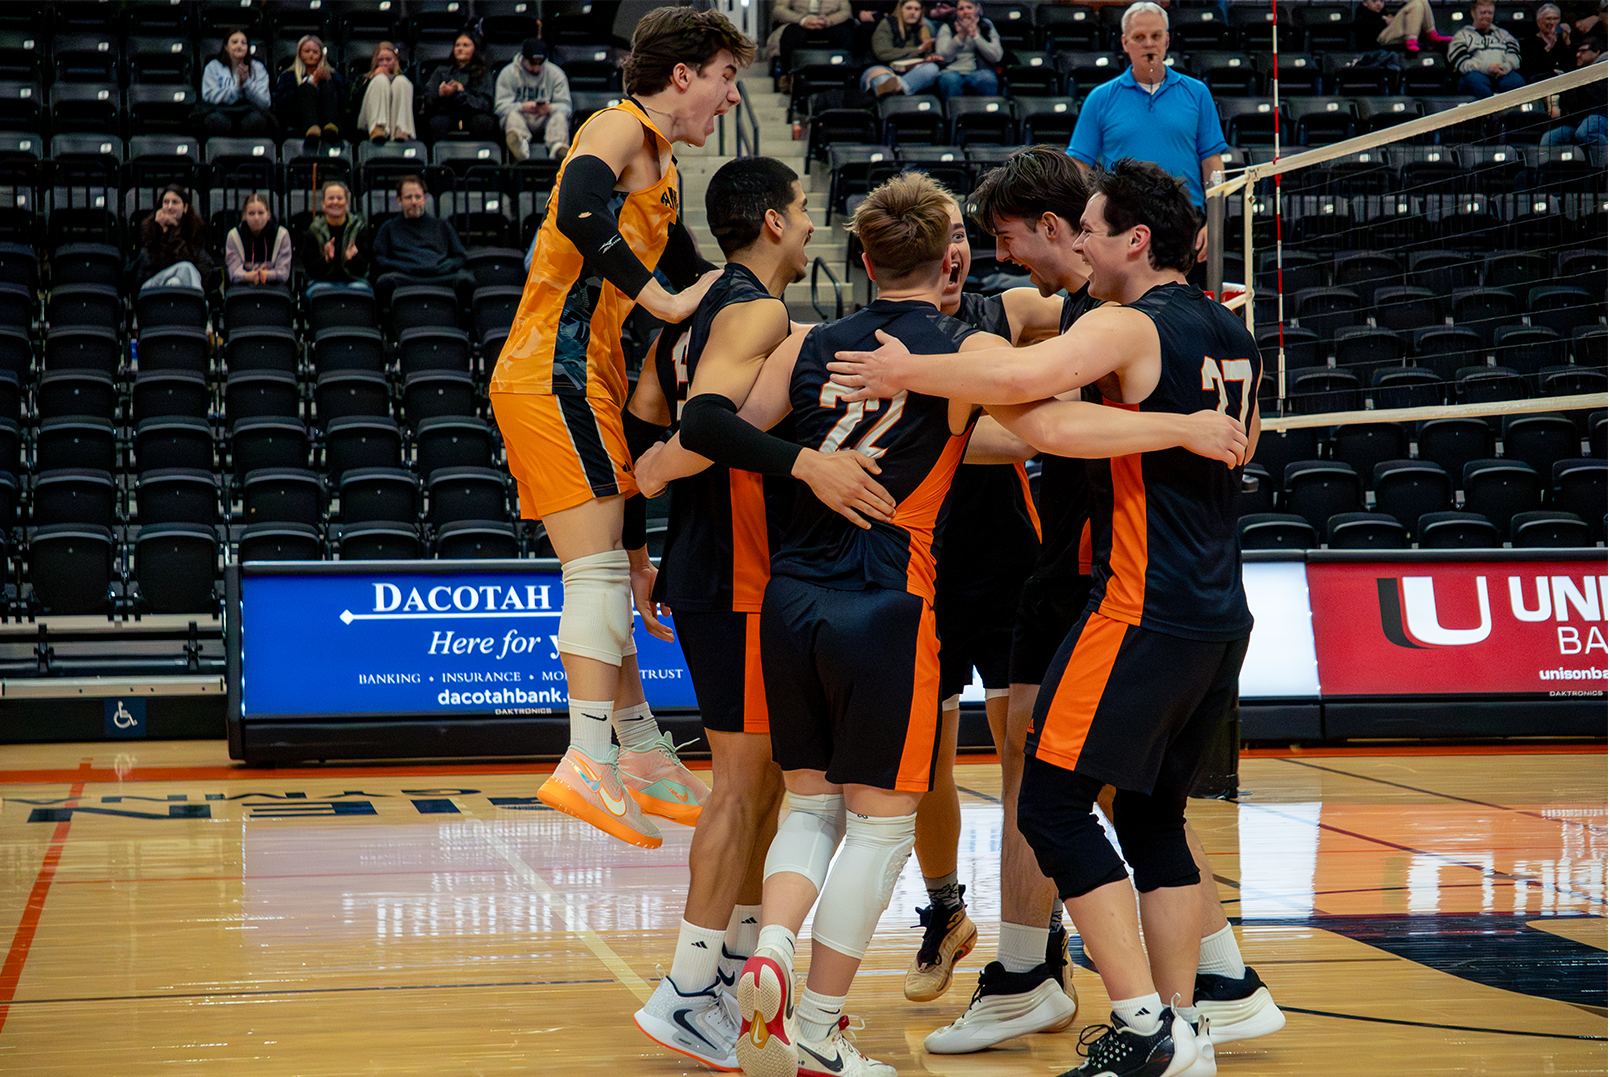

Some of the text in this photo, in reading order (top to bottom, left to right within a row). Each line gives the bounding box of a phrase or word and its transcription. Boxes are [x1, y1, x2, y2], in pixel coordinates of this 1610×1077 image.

[818, 379, 909, 459] 22
[372, 583, 551, 611] DACOTAH
[427, 631, 495, 655] Here
[496, 629, 541, 660] for
[359, 668, 684, 684] BANKING INSURANCE TRUST
[437, 686, 569, 705] dacotahbank.
[494, 707, 552, 715] DAKTRONICS
